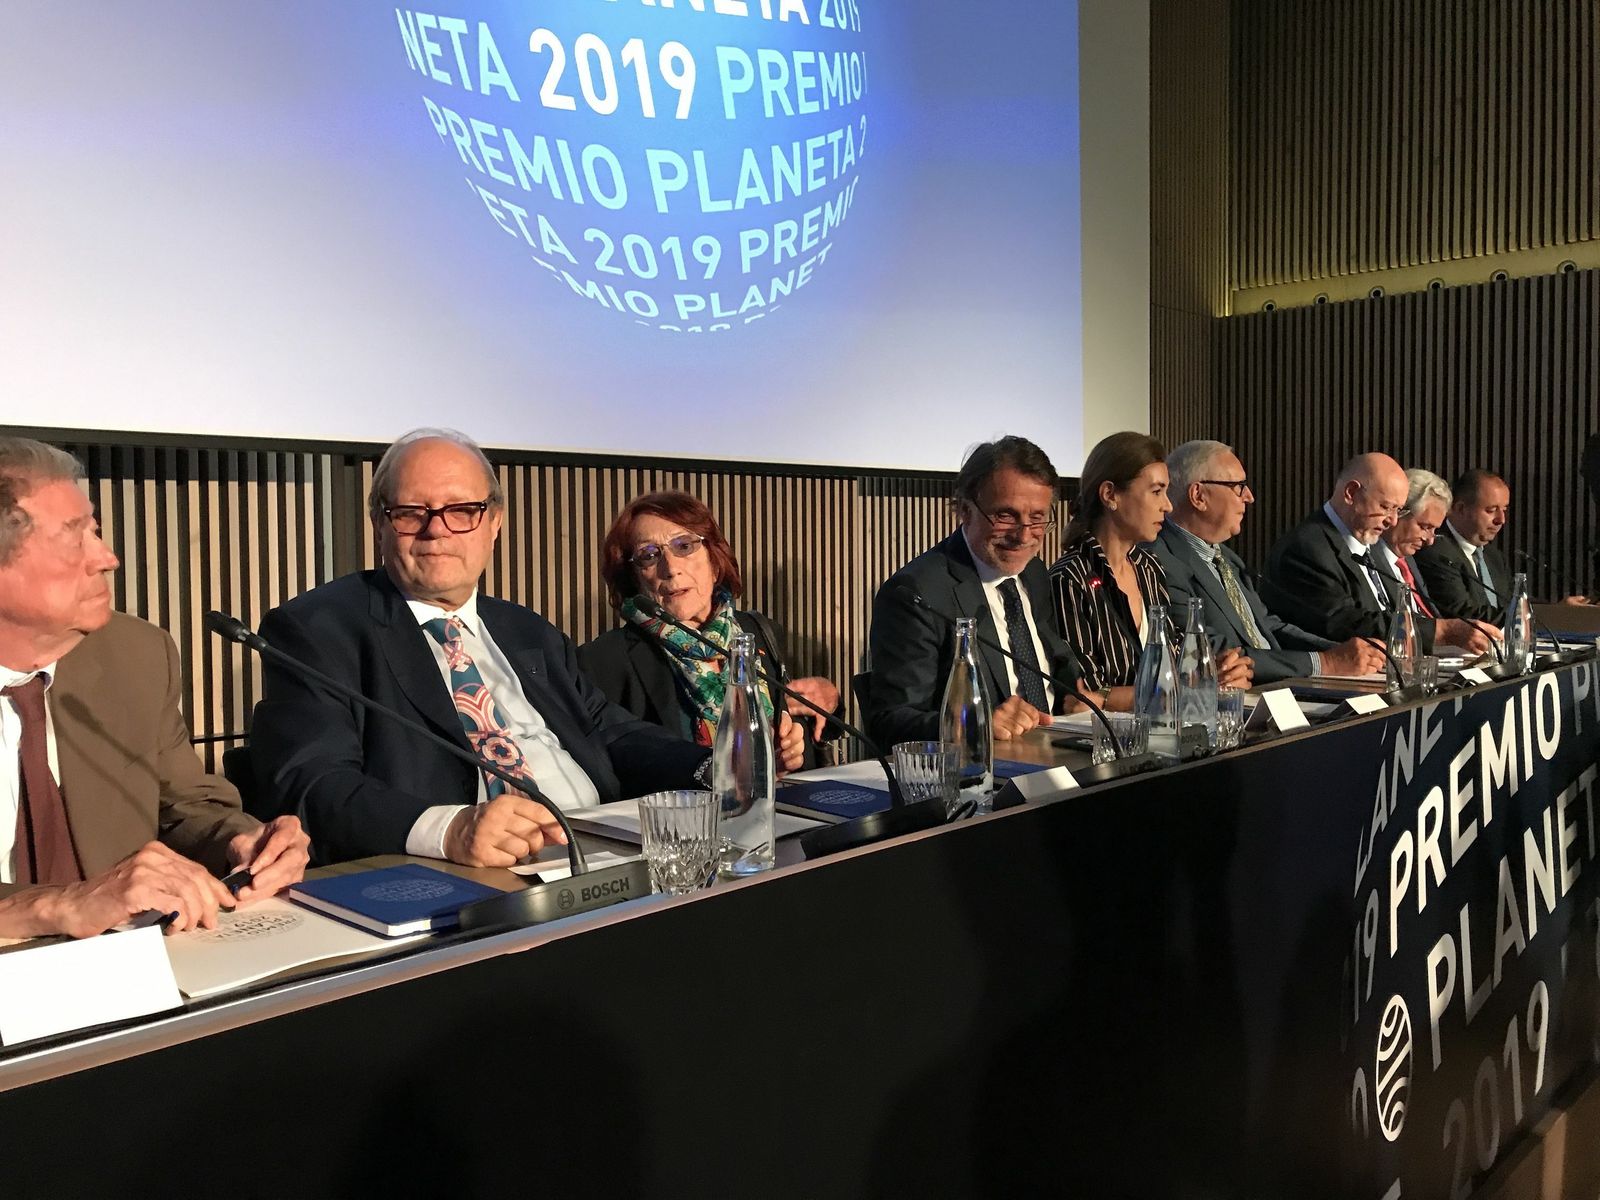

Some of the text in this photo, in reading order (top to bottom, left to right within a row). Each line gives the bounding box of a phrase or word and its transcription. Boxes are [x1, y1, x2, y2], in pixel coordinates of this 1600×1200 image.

[394, 7, 521, 102] NETA
[528, 27, 696, 120] 2019
[715, 45, 862, 120] PREMIO
[422, 95, 628, 211] PREMIO
[646, 124, 856, 213] PLANETA
[465, 177, 579, 265] ETA
[583, 227, 722, 281] 2019
[1389, 671, 1562, 959] PREMIO
[581, 877, 630, 902] BOSCH
